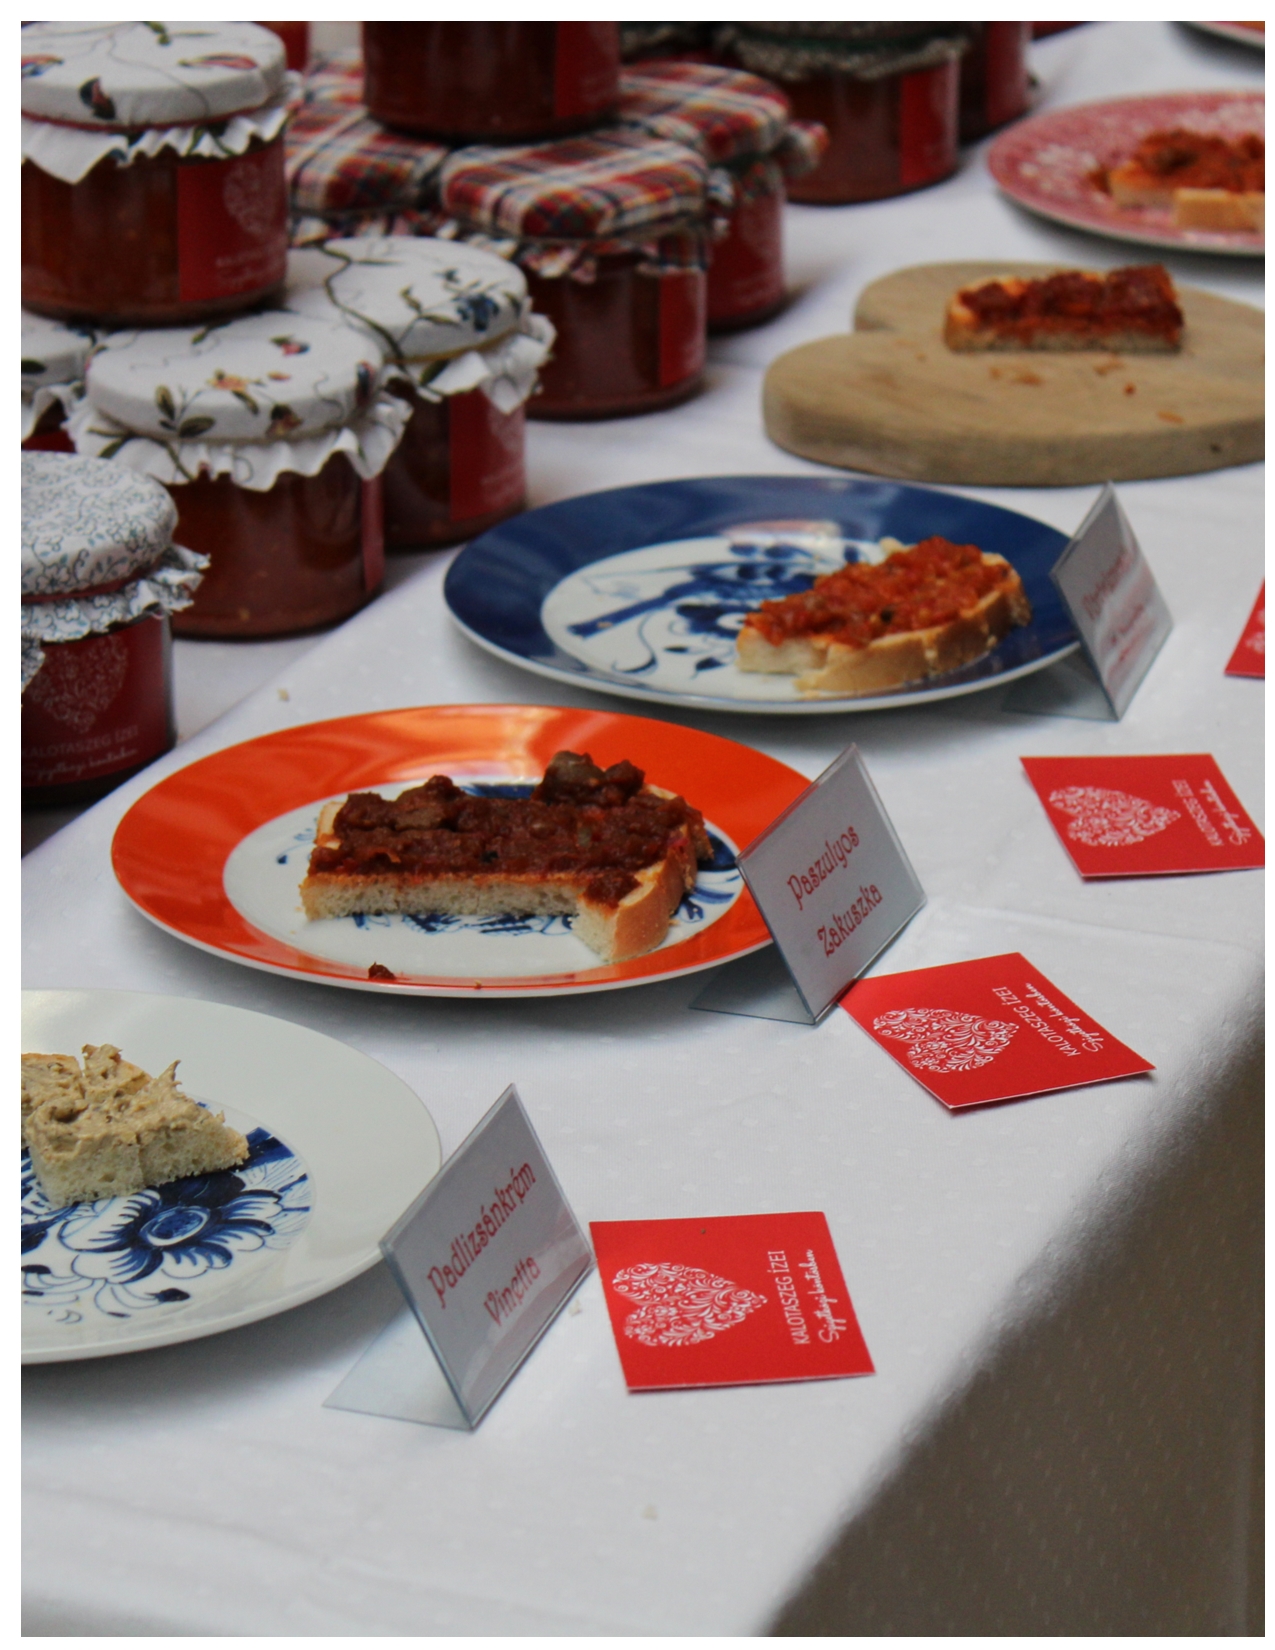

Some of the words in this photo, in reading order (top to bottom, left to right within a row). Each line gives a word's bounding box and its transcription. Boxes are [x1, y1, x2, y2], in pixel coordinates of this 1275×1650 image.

[816, 882, 883, 958] Zakuszka
[1013, 1005, 1082, 1058] KALOTASZEG
[428, 1161, 536, 1308] Padlizsánkrém
[767, 1250, 790, 1274] ÍZEI
[483, 1255, 541, 1327] Vinetta
[775, 1275, 811, 1345] KALOTASZEG
